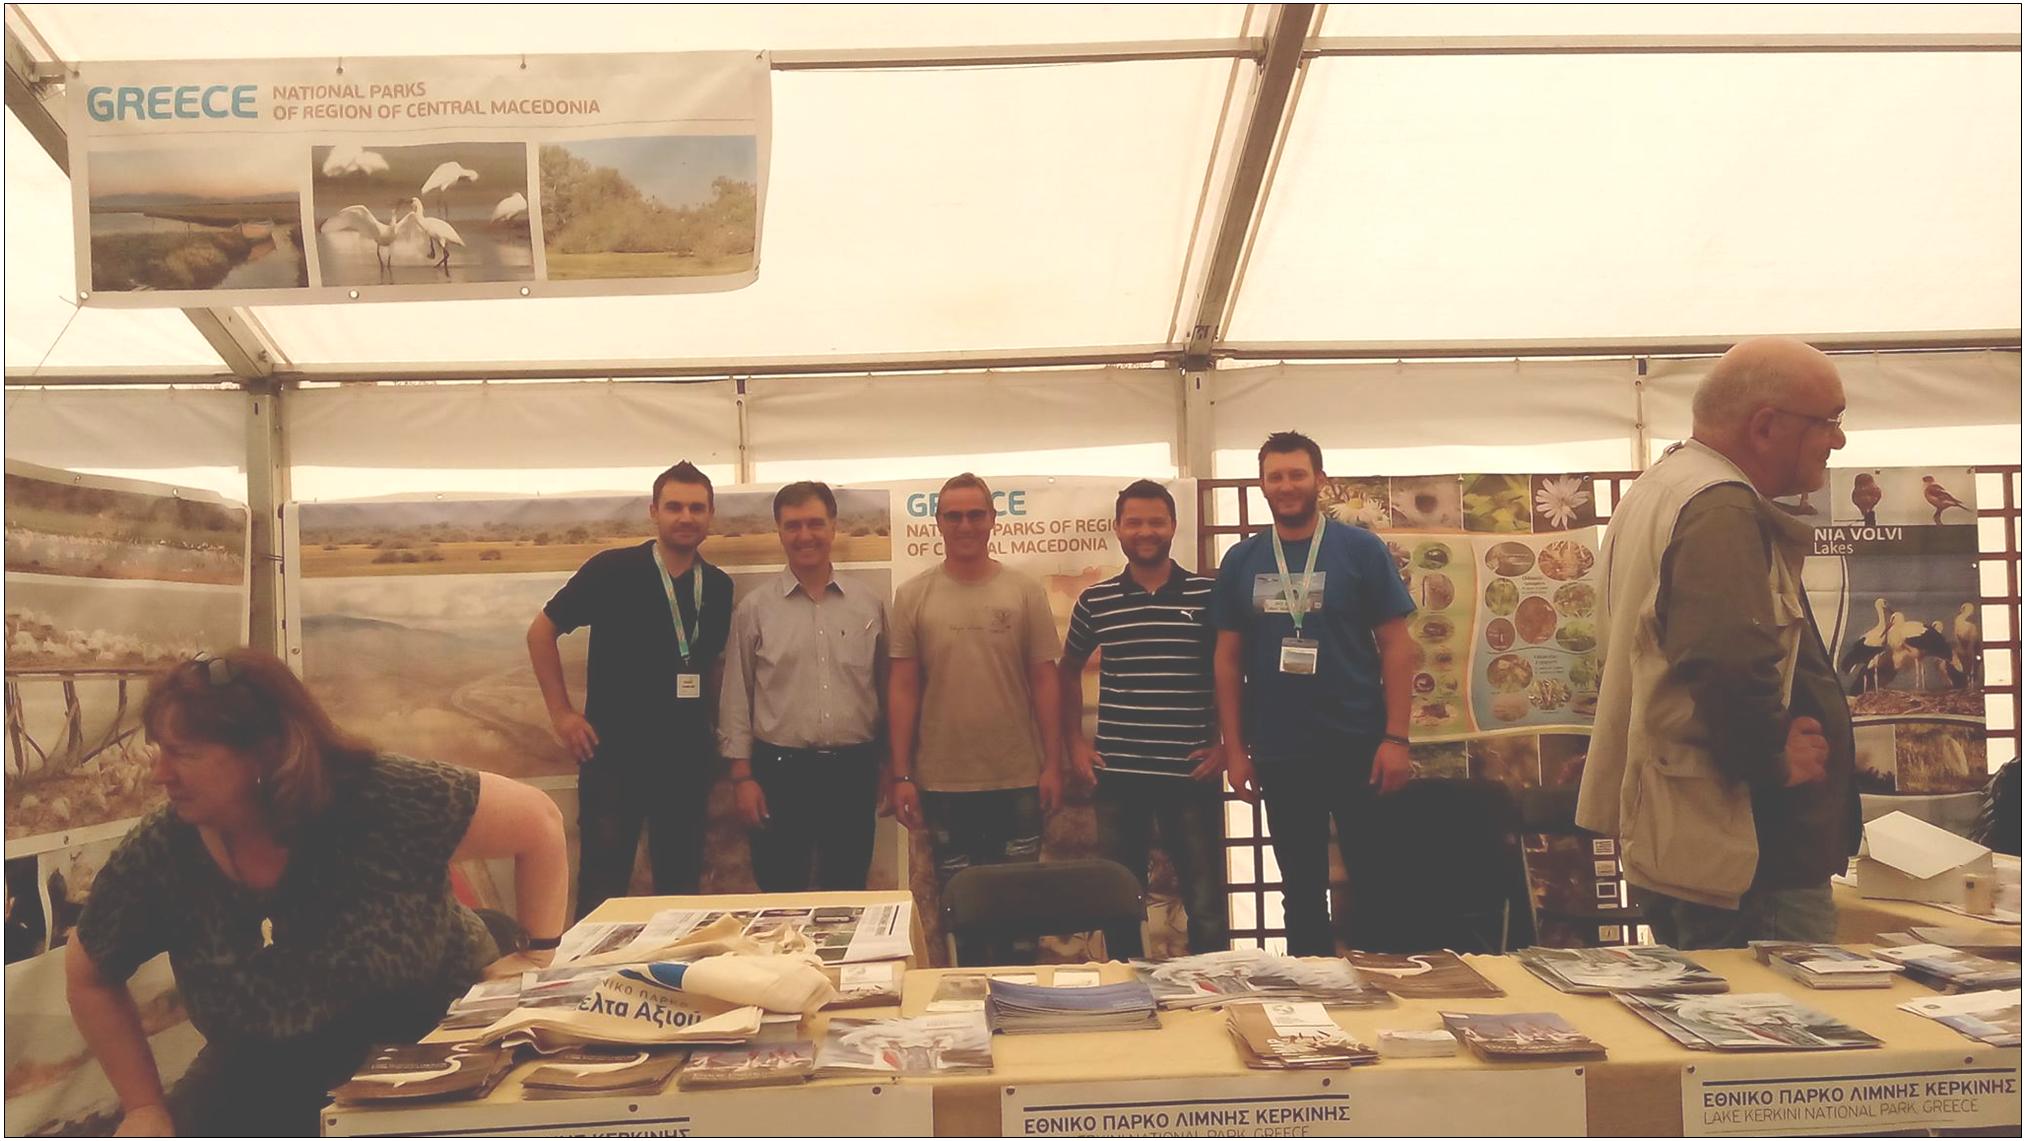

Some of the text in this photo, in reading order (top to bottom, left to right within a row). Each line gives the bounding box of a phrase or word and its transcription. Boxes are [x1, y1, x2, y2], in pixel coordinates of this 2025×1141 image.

[272, 82, 426, 100] NATIONAL PARKS
[87, 85, 258, 122] GREECE
[272, 99, 600, 120] OF REGION OF CENTRAL MACEDONIA
[993, 521, 1045, 536] PARKS
[1050, 520, 1071, 534] OF
[1075, 519, 1117, 533] REGI
[1850, 527, 1902, 541] VOLVI
[907, 542, 929, 556] OF
[1011, 538, 1108, 554] MACEDONIA
[1814, 541, 1854, 555] Lakes
[1703, 1078, 2017, 1107] ΕΘΝΙΚΟ ΠΑΡΚΟ ΛΙΜΝΗΣ ΚΕΡΚΙΝΗΣ
[1024, 1106, 1350, 1134] ΕΘΝΙΚΟ ΠΑΡΚΟ ΛΙΜΝΗΣ ΚΕΡΚΙΝΗΣ
[1704, 1109, 1741, 1125] LAKE
[1744, 1107, 1804, 1122] KERKINI
[1805, 1104, 1876, 1120] NATIONAL
[1922, 1098, 1979, 1113] GREECE
